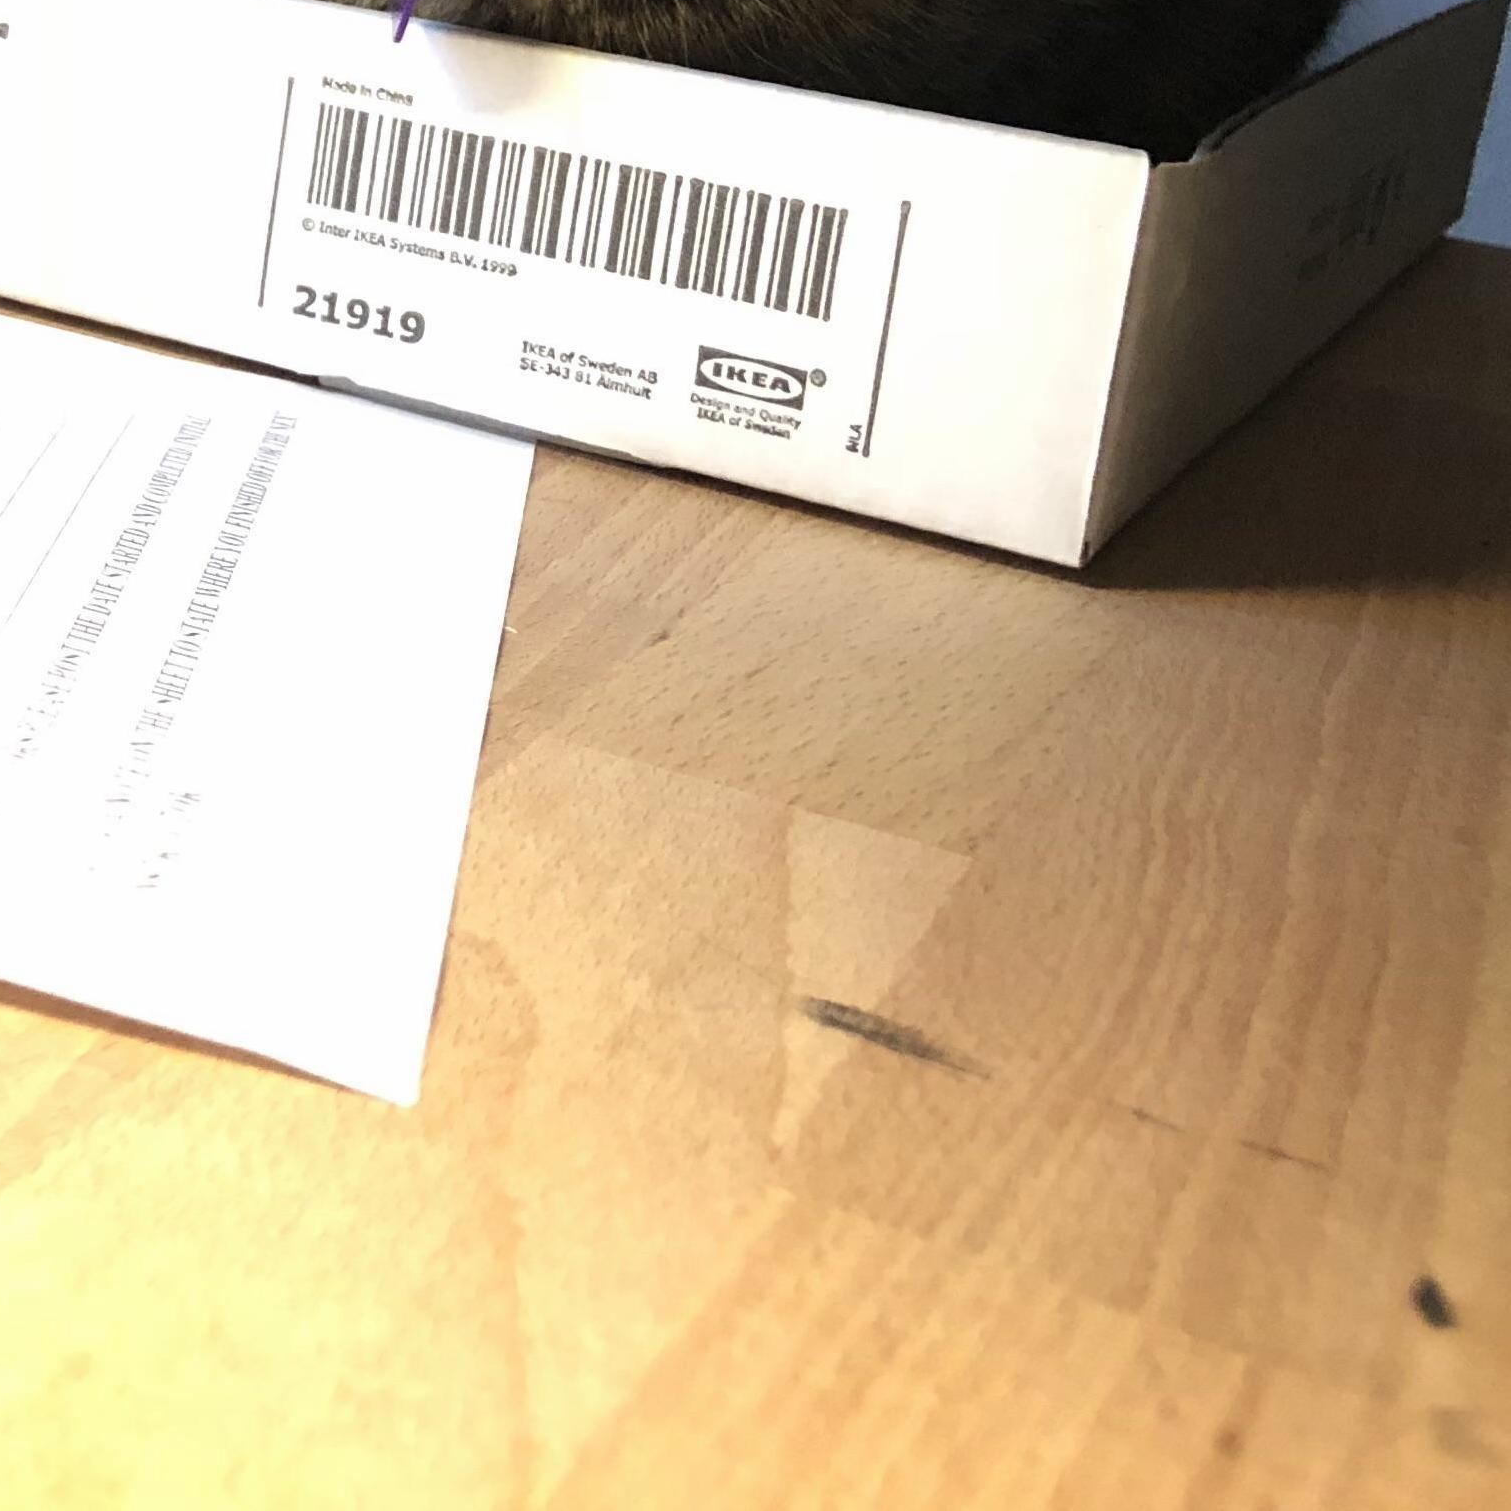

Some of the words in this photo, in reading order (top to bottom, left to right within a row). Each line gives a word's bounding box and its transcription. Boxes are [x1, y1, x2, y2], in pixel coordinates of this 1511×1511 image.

[322, 77, 357, 94] Made
[360, 85, 371, 96] in
[376, 88, 413, 106] China
[320, 221, 351, 238] Inter
[354, 229, 385, 247] IKEA
[390, 238, 445, 261] Systems
[450, 252, 477, 268] B.V.
[481, 259, 517, 277] 1999
[293, 285, 425, 344] 21919
[520, 357, 570, 379] SE-343
[522, 341, 555, 359] IKEA
[560, 352, 575, 363] of
[579, 355, 632, 377] Sweden
[637, 369, 657, 384] AB
[710, 362, 791, 393] IKEA
[690, 393, 730, 414] Design
[734, 406, 756, 416] and
[759, 409, 801, 430] Quality
[697, 407, 725, 423] IKEA
[729, 417, 742, 426] of
[131, 504, 162, 527] AND
[225, 481, 267, 532] FINISHED
[101, 523, 150, 579] STARTED
[194, 553, 239, 598] WHERE
[82, 579, 124, 616] DATE
[66, 614, 106, 644] THE
[181, 598, 219, 639] STATE
[169, 640, 201, 660] TO
[152, 660, 193, 703] SHEET
